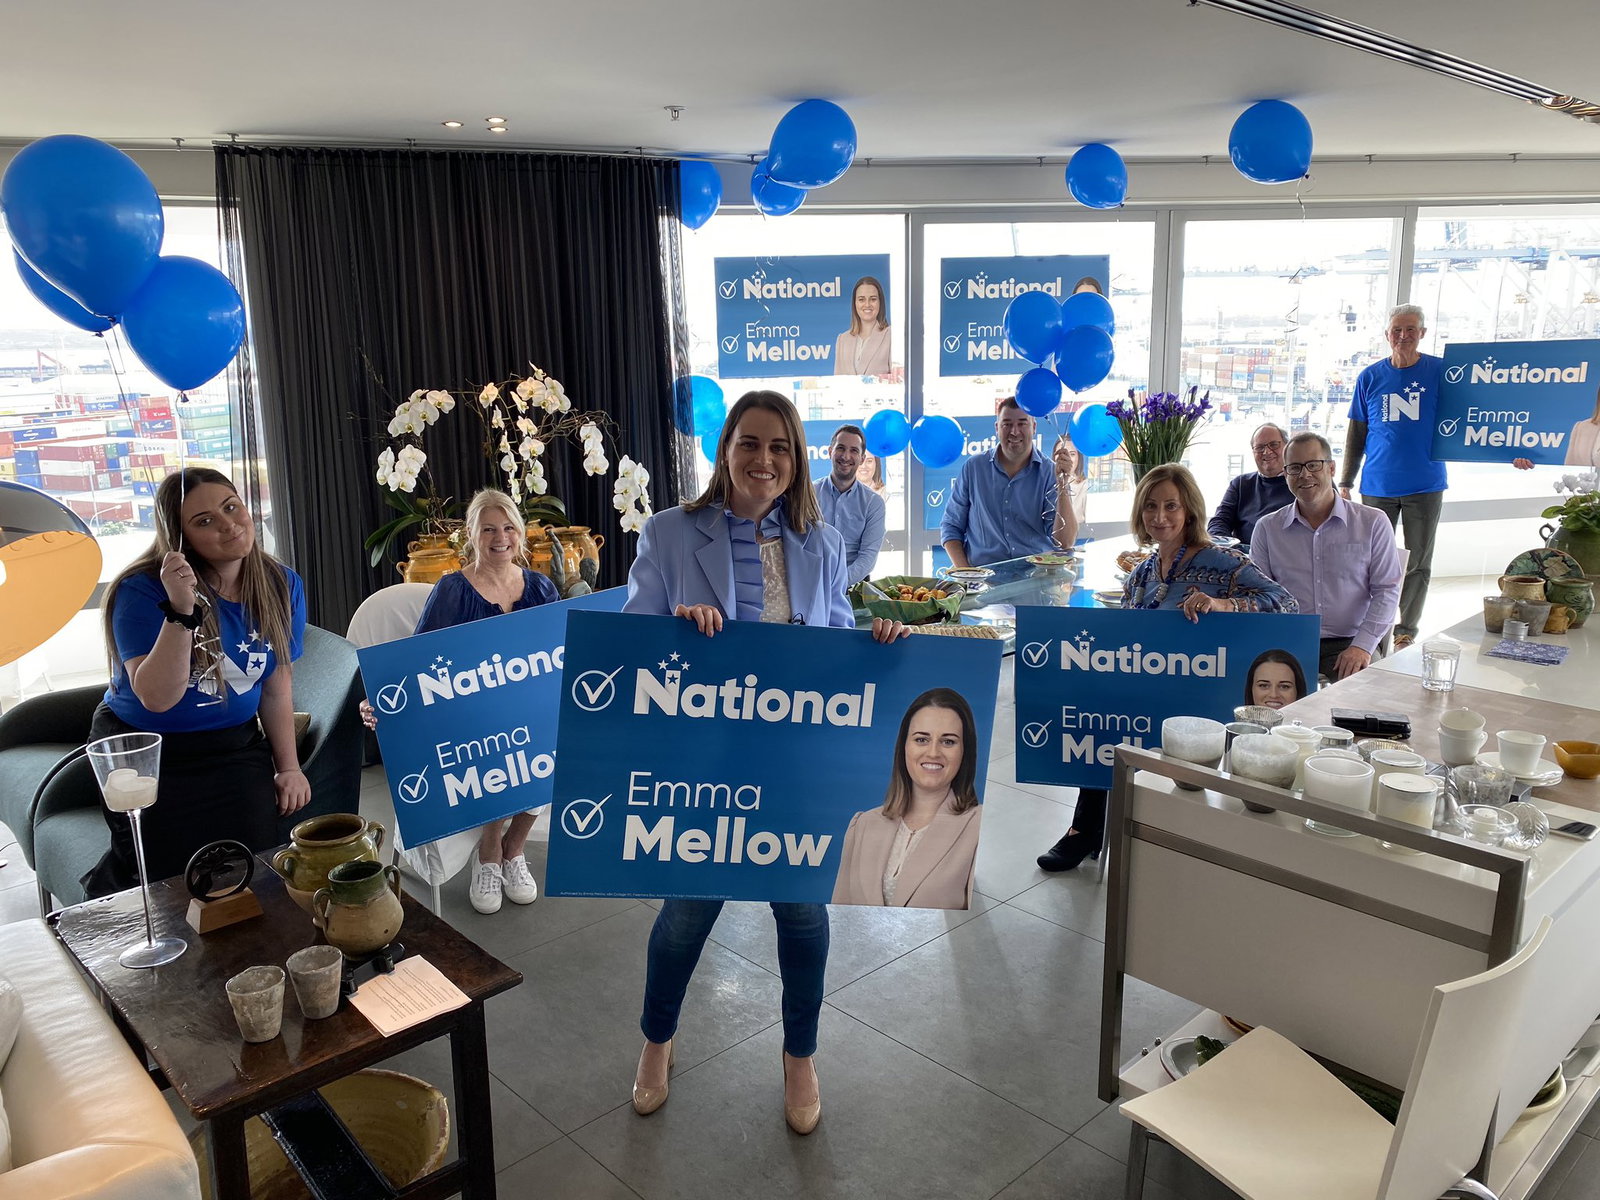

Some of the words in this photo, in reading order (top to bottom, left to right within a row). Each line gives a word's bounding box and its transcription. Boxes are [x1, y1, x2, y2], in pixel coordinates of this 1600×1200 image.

[743, 276, 841, 300] National
[745, 321, 800, 339] Emma
[967, 321, 1004, 338] Emm
[746, 339, 831, 362] Mellow
[967, 338, 1024, 361] Mell
[1470, 361, 1589, 385] National
[1381, 393, 1389, 423] National
[1467, 407, 1531, 424] Emma
[1464, 425, 1566, 449] Mellow
[1060, 640, 1227, 678] National
[416, 645, 565, 706] Nationa
[633, 667, 877, 728] National
[1061, 705, 1152, 733] Emma
[436, 724, 532, 770] Emma
[442, 749, 557, 808] Mello
[627, 771, 763, 811] Emma
[622, 814, 832, 868] Mellow
